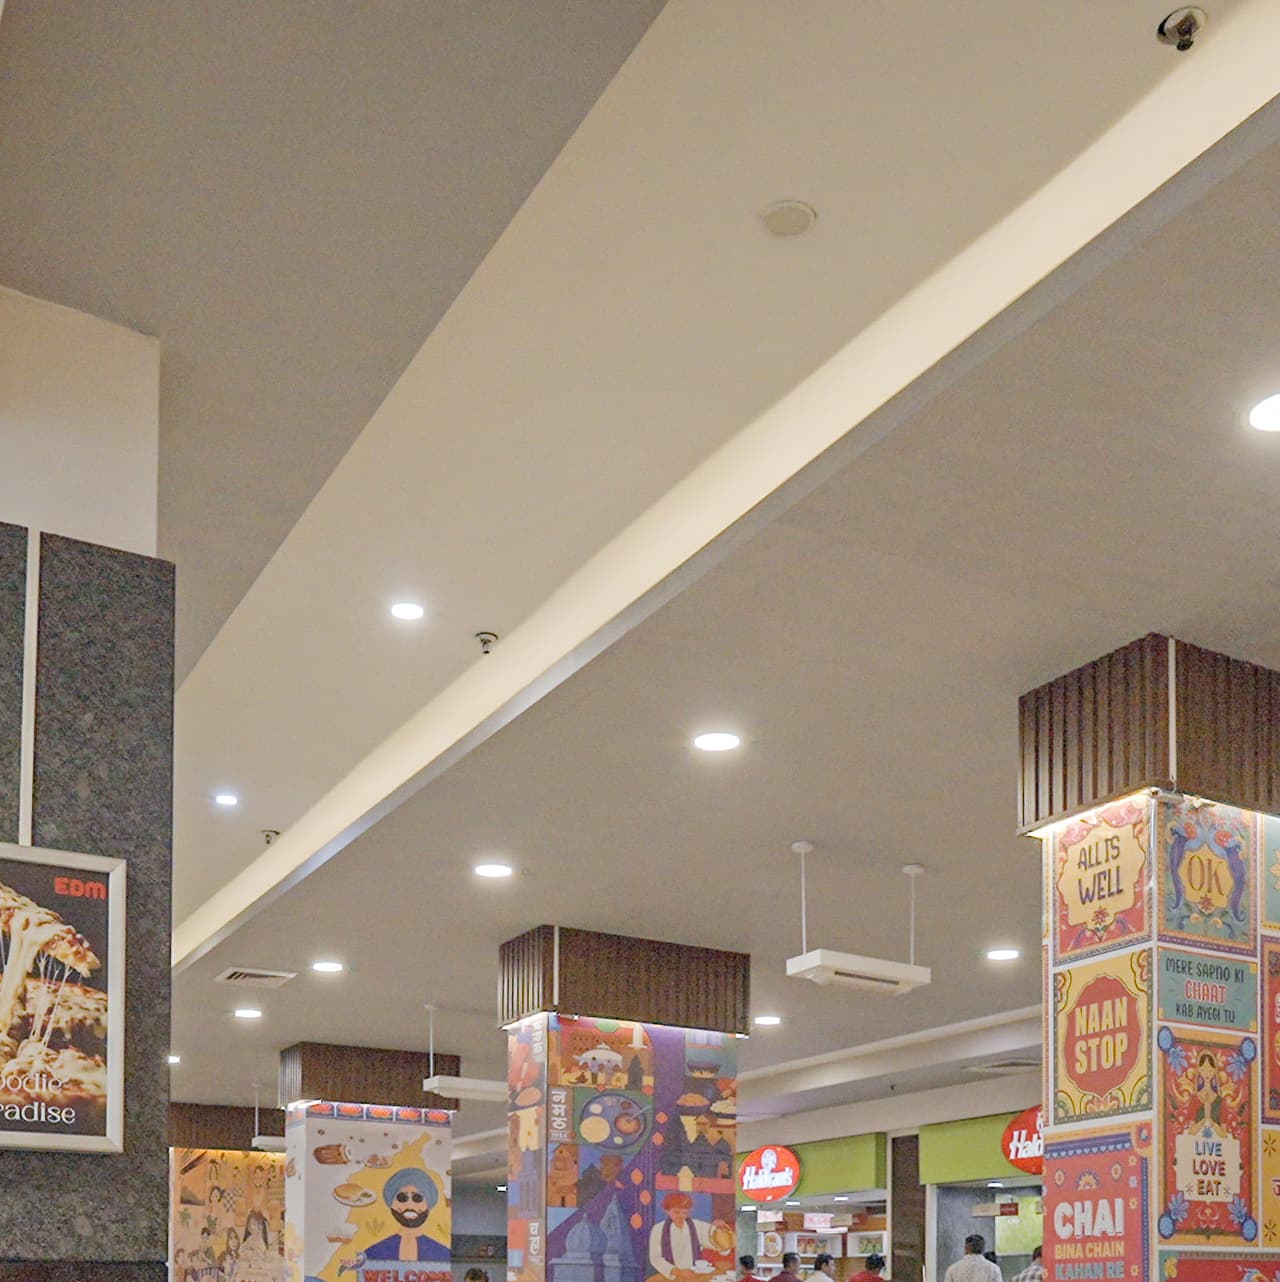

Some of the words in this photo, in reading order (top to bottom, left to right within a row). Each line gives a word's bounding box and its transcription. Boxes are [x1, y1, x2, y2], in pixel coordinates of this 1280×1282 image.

[1076, 840, 1102, 870] ALL
[1104, 835, 1120, 864] IS
[1078, 866, 1124, 905] WELL
[1186, 855, 1224, 896] OK
[1166, 957, 1193, 976] MERE
[1196, 962, 1231, 981] SAPNO
[1234, 967, 1244, 983] KI
[1184, 978, 1227, 1005] CHAAT
[1075, 997, 1128, 1037] NAAN
[1176, 1002, 1194, 1018] KAB
[1197, 1005, 1220, 1021] AYEGI
[1224, 1008, 1235, 1023] TU
[1075, 1032, 1129, 1075] STOP
[1195, 1141, 1222, 1157] LIVE
[1193, 1160, 1226, 1177] LOVE
[1196, 1179, 1223, 1197] EAT
[1054, 1197, 1125, 1240] CHAI
[1055, 1243, 1083, 1259] BINA
[1086, 1241, 1124, 1258] CHAIN
[1056, 1262, 1104, 1280] KAHAN
[1106, 1260, 1125, 1278] RE
